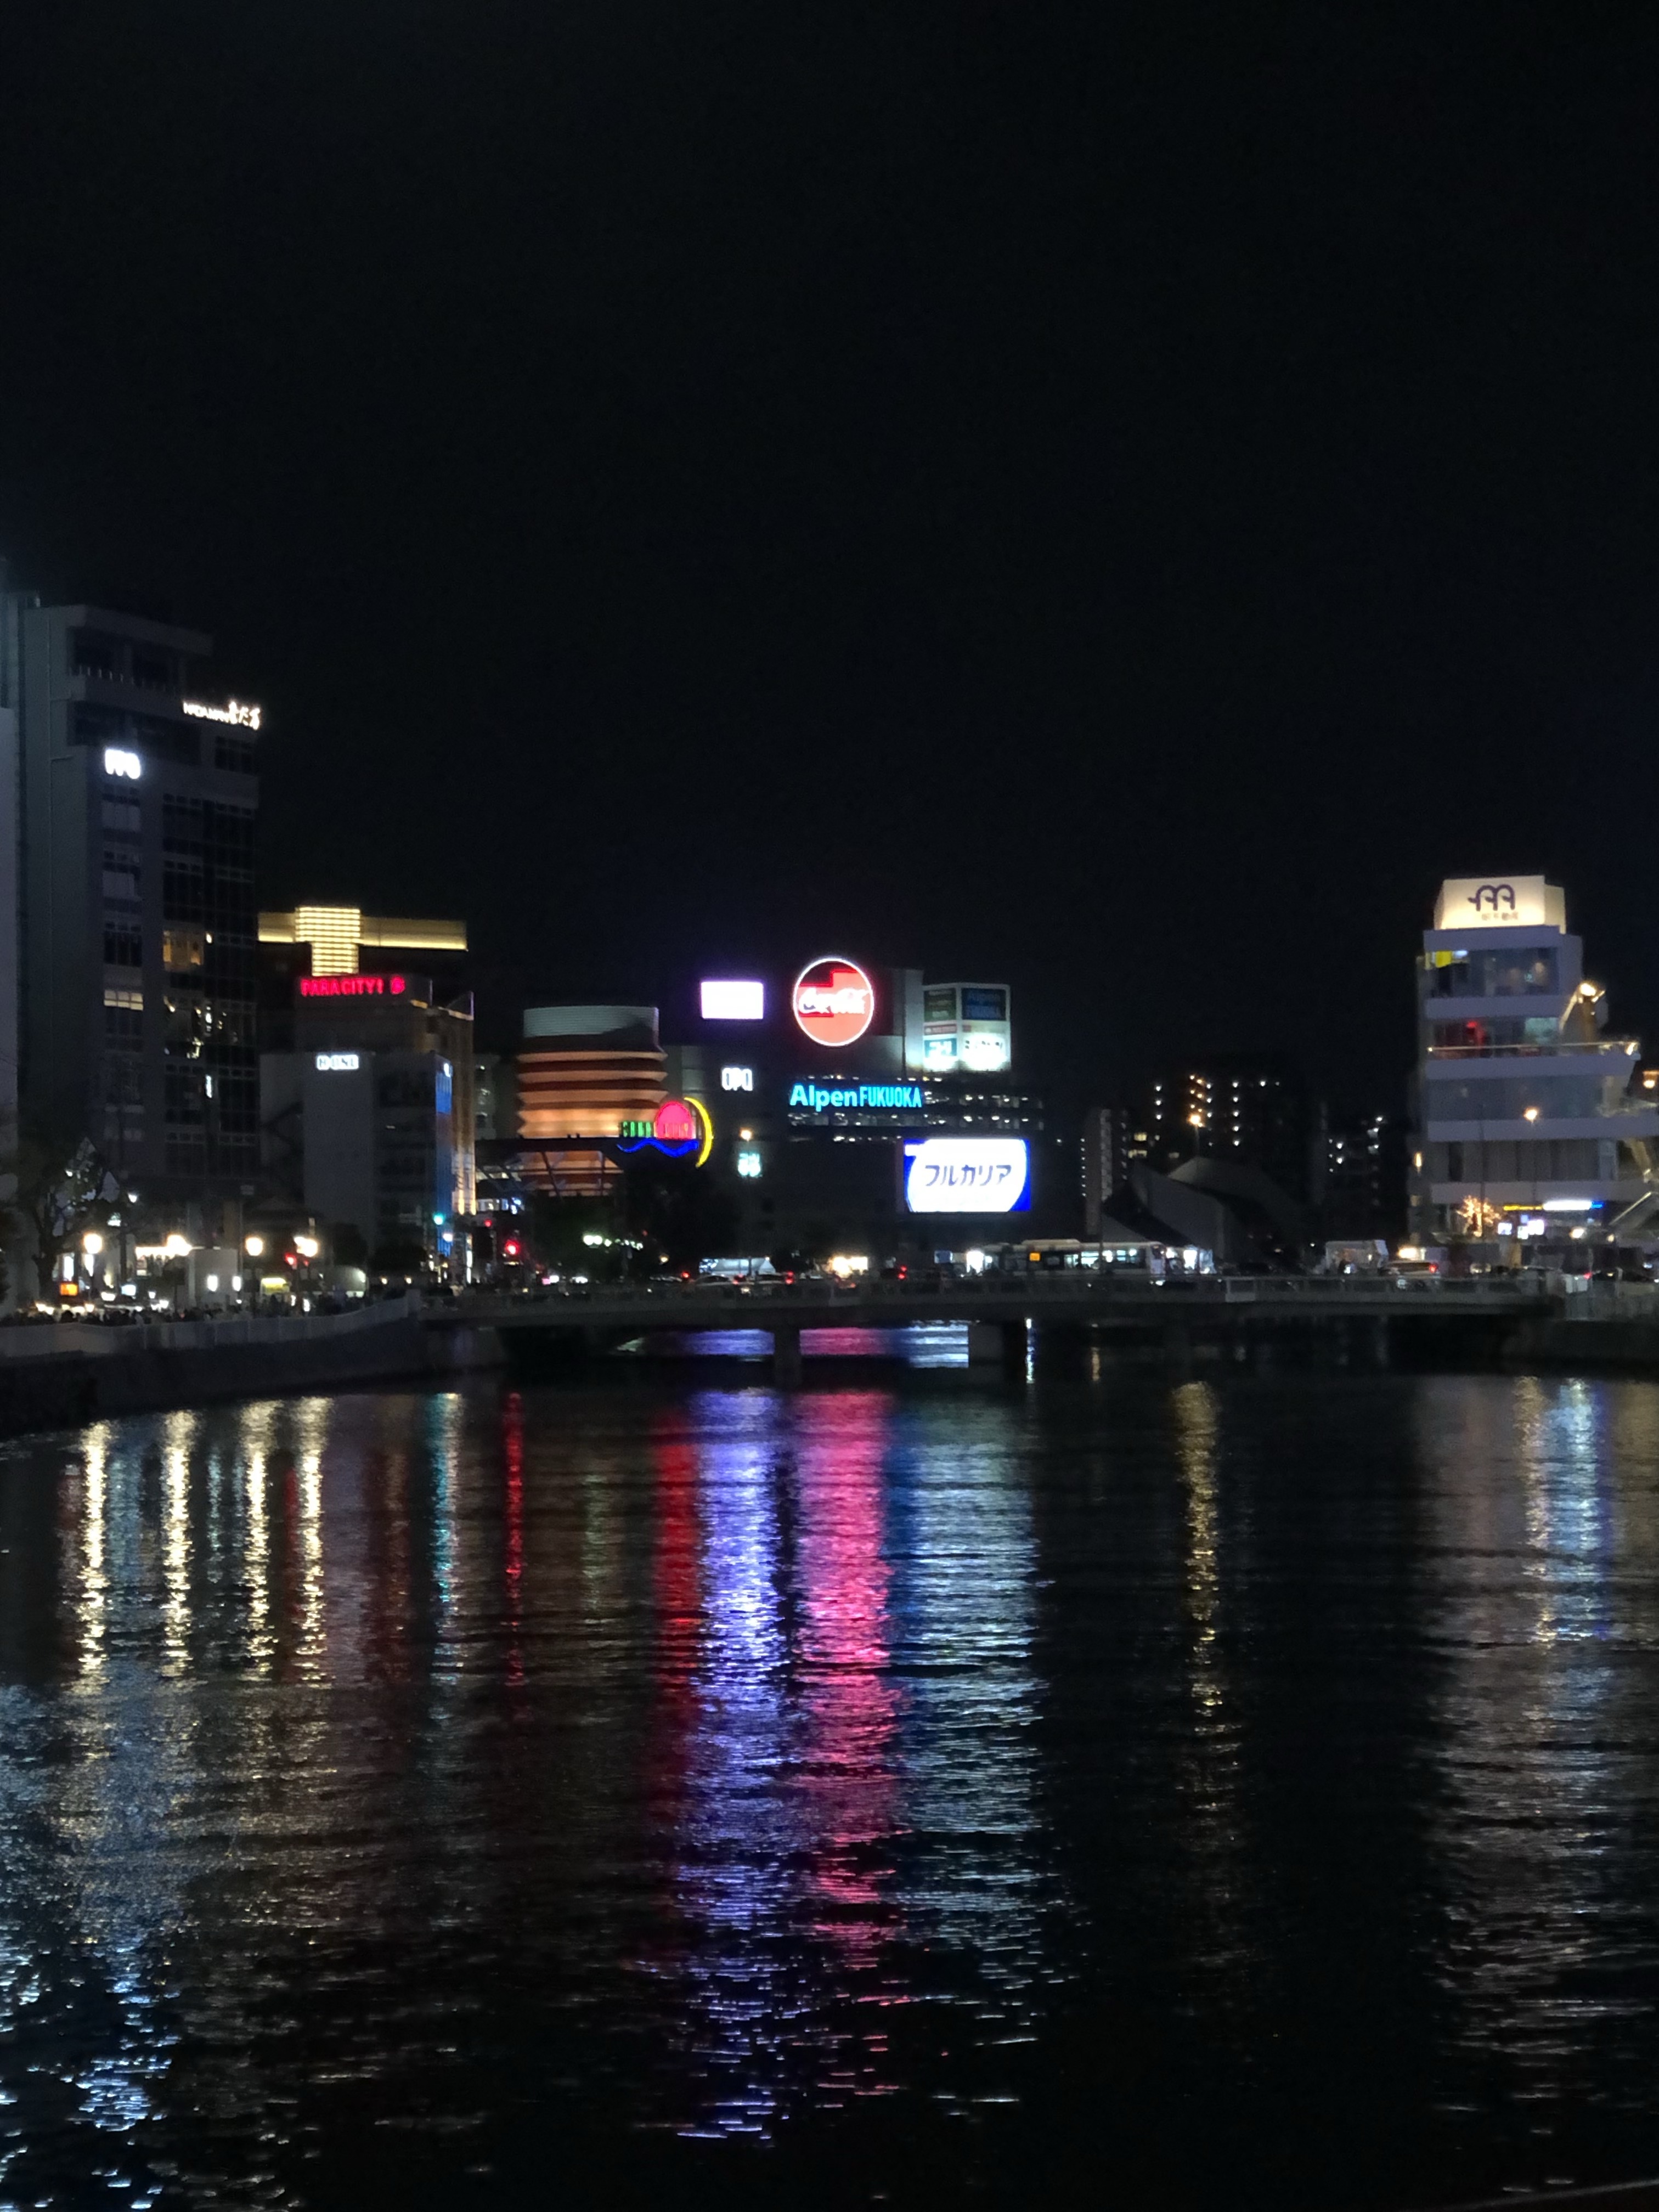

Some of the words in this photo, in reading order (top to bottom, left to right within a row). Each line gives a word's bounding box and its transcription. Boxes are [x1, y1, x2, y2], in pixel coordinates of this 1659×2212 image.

[789, 1085, 857, 1112] Alpen
[860, 1086, 922, 1108] FUKUOKA
[925, 1164, 1012, 1187] フルカリア
